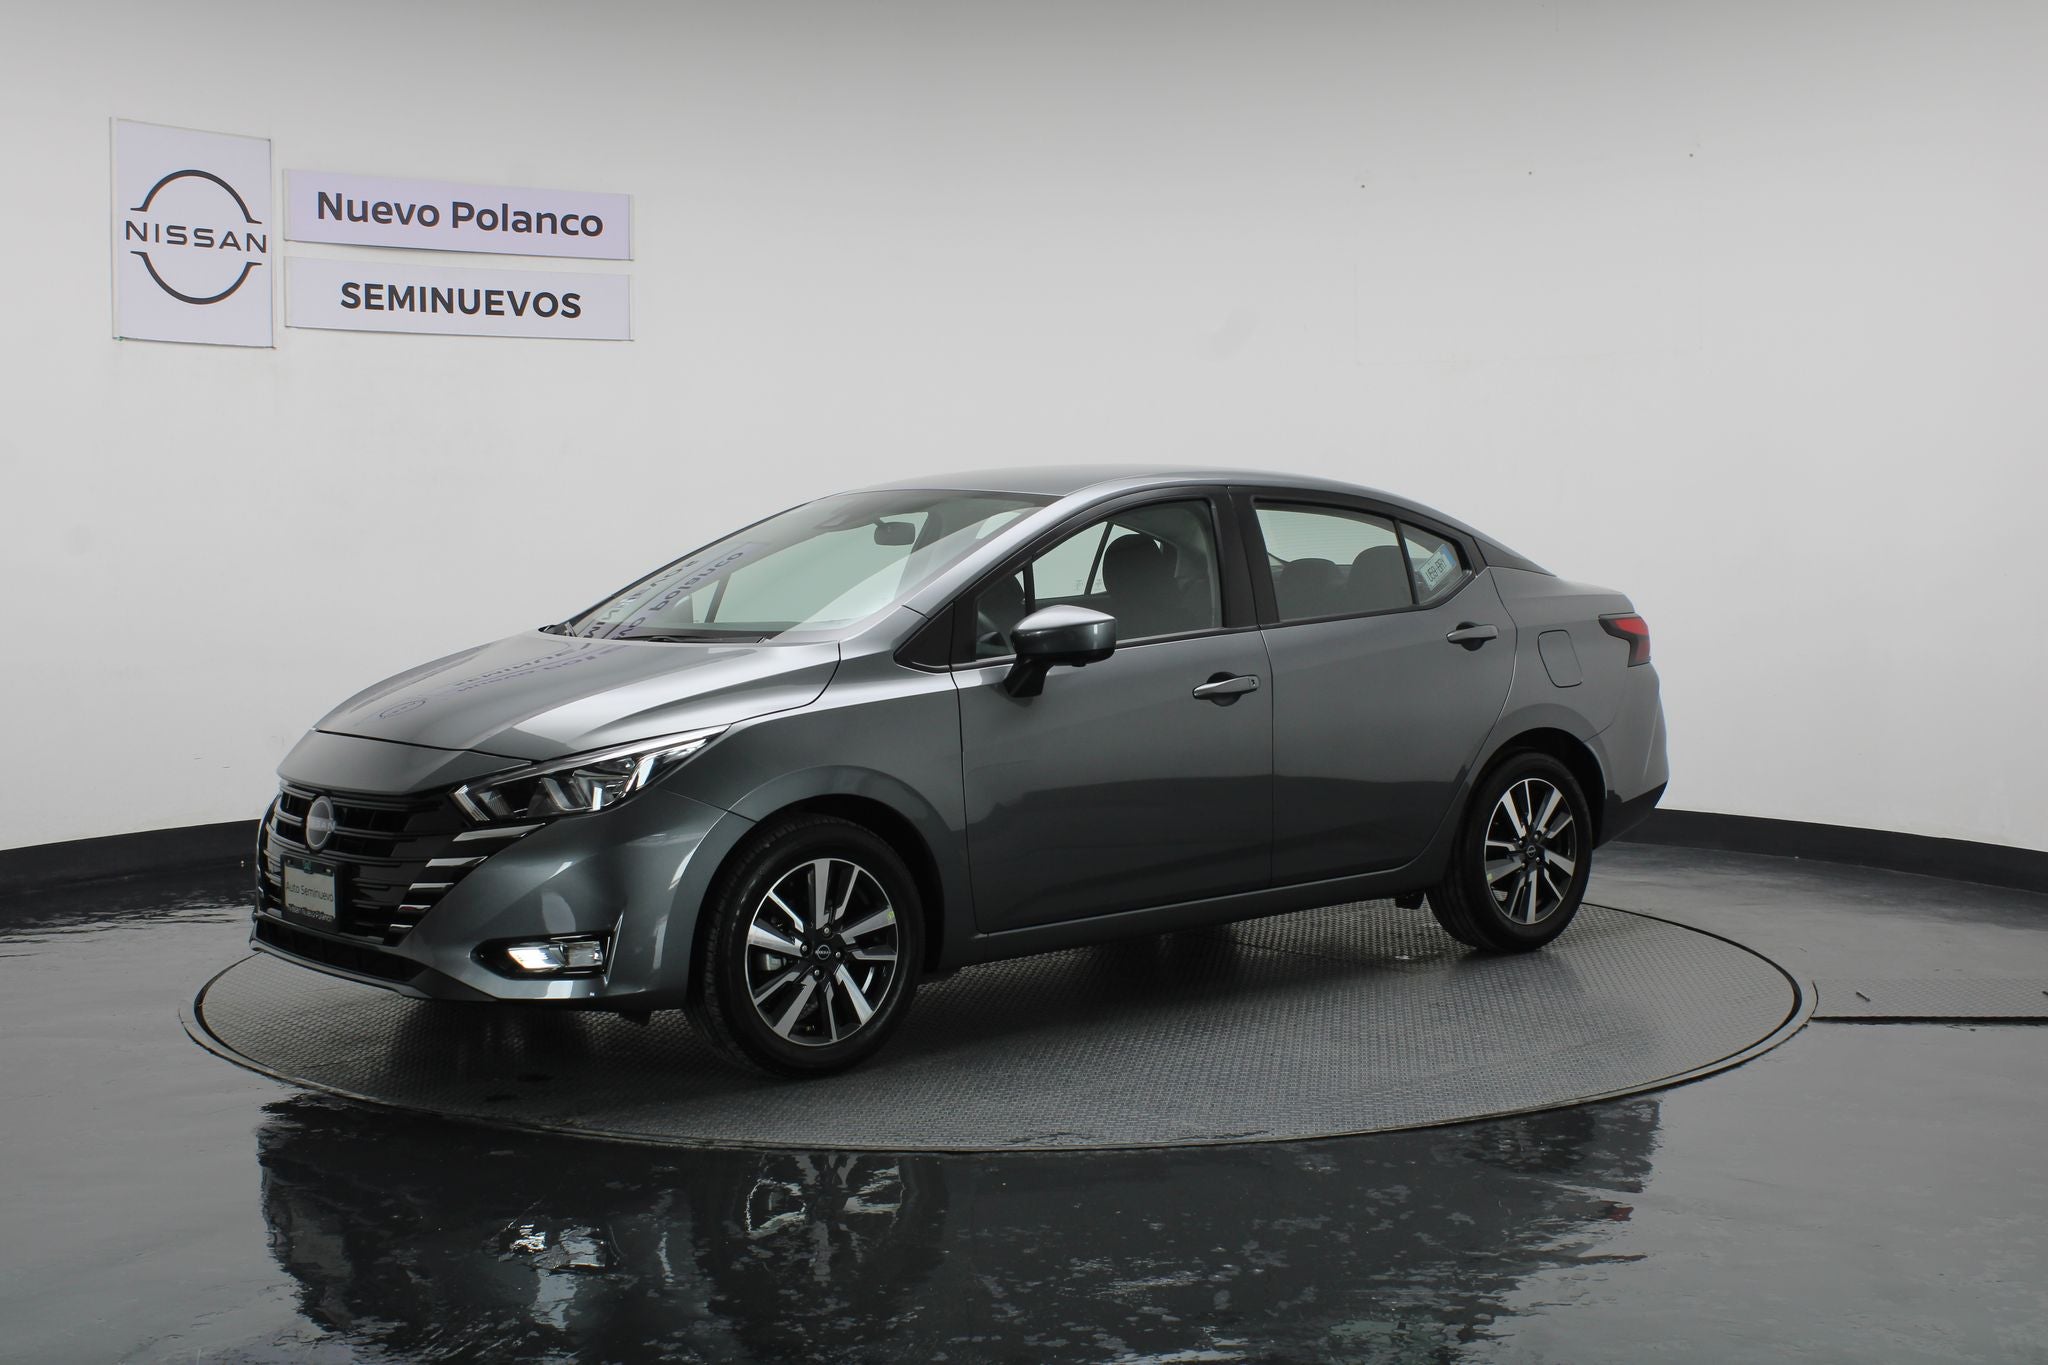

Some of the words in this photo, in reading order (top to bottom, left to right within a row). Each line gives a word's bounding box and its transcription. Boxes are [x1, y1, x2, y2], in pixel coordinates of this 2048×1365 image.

[317, 191, 440, 228] Nuevo
[452, 201, 604, 237] Polanco
[125, 220, 266, 254] NISSAN
[340, 281, 582, 319] SEMINUEVOS
